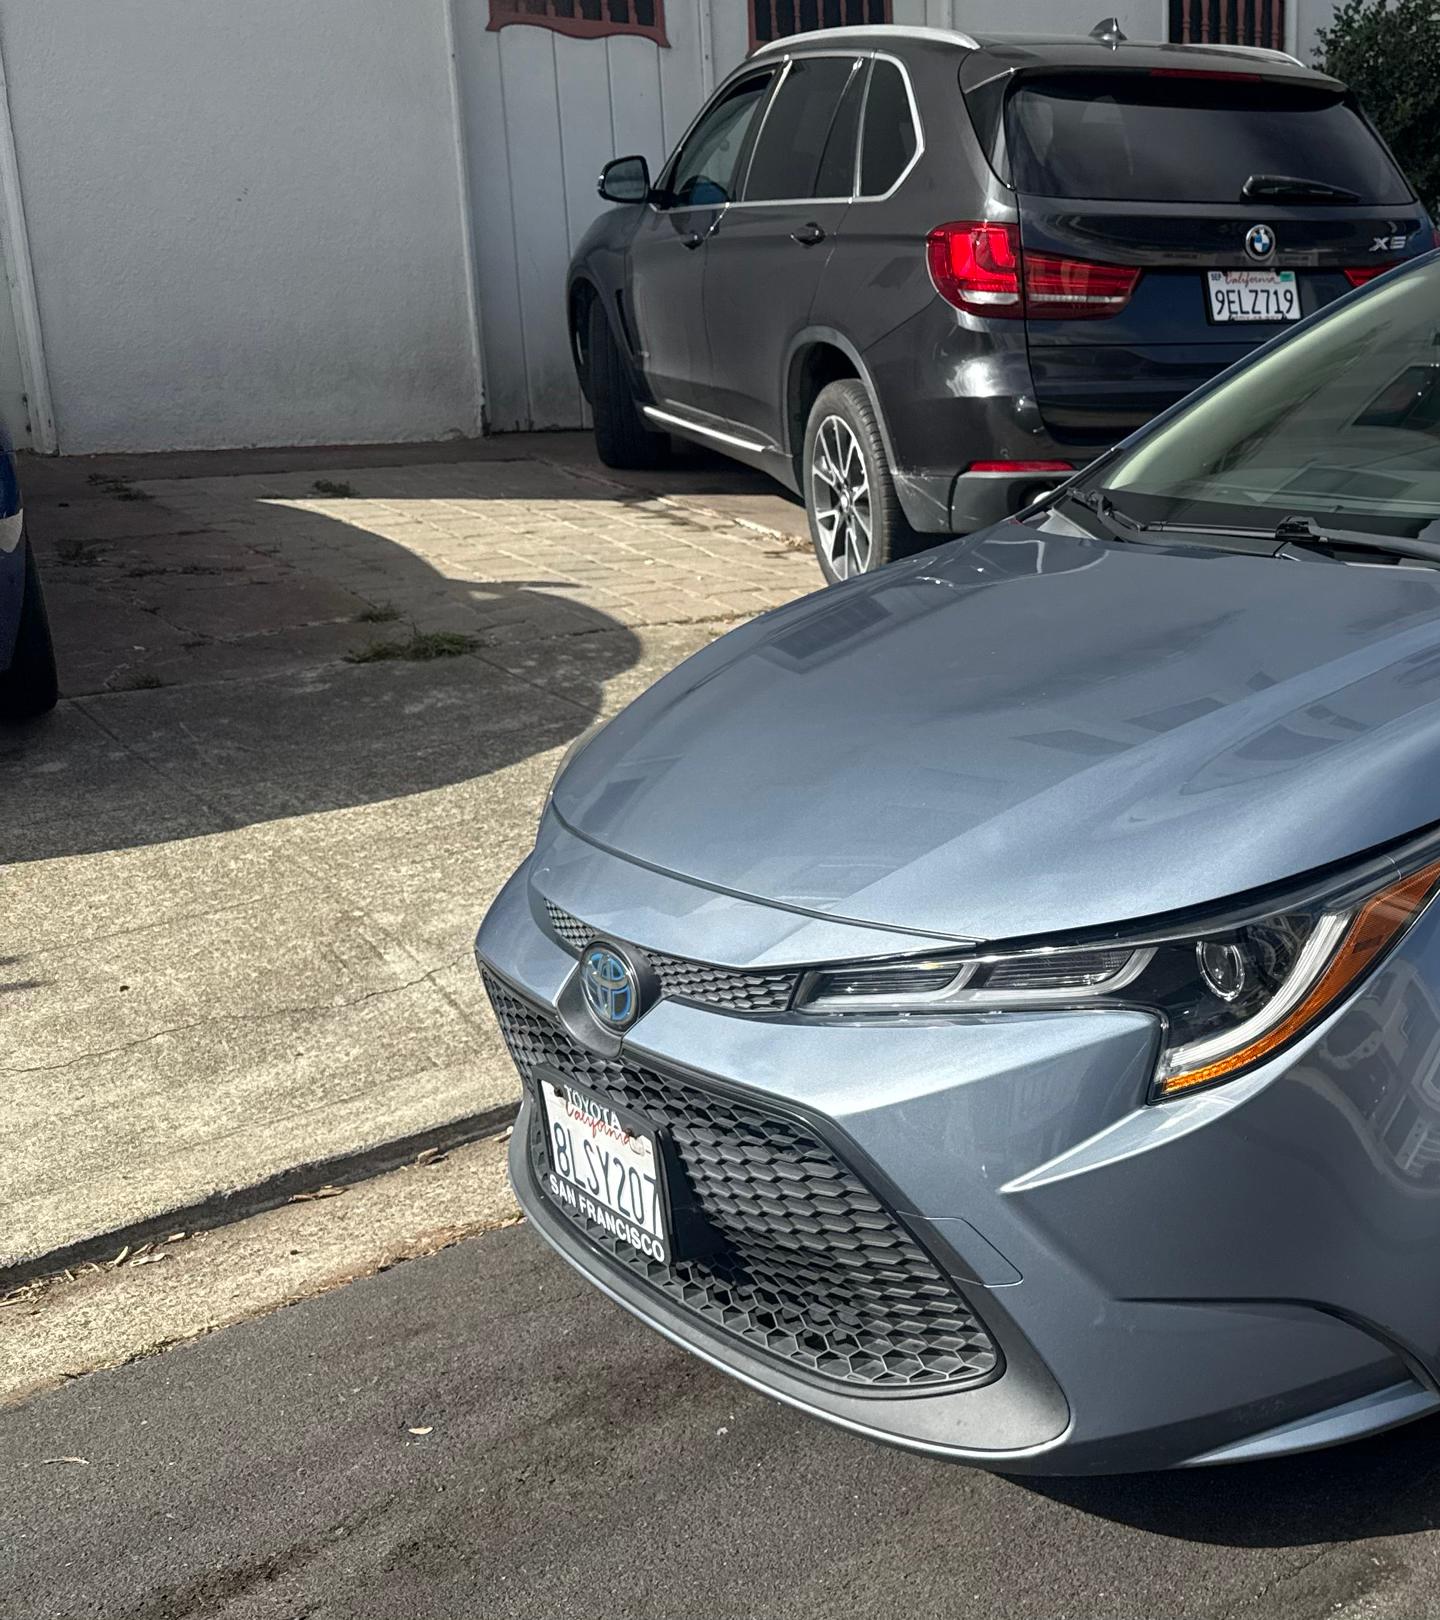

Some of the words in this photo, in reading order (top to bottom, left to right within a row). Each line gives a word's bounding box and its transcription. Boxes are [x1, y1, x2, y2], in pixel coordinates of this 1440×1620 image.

[1369, 236, 1407, 252] X5
[1224, 271, 1281, 288] California
[1215, 289, 1294, 316] 9ELZ719
[564, 1085, 622, 1132] TOYOTA
[553, 1121, 658, 1236] 8LSY207
[550, 1174, 577, 1208] SAN
[579, 1198, 665, 1263] FRANCISCO
